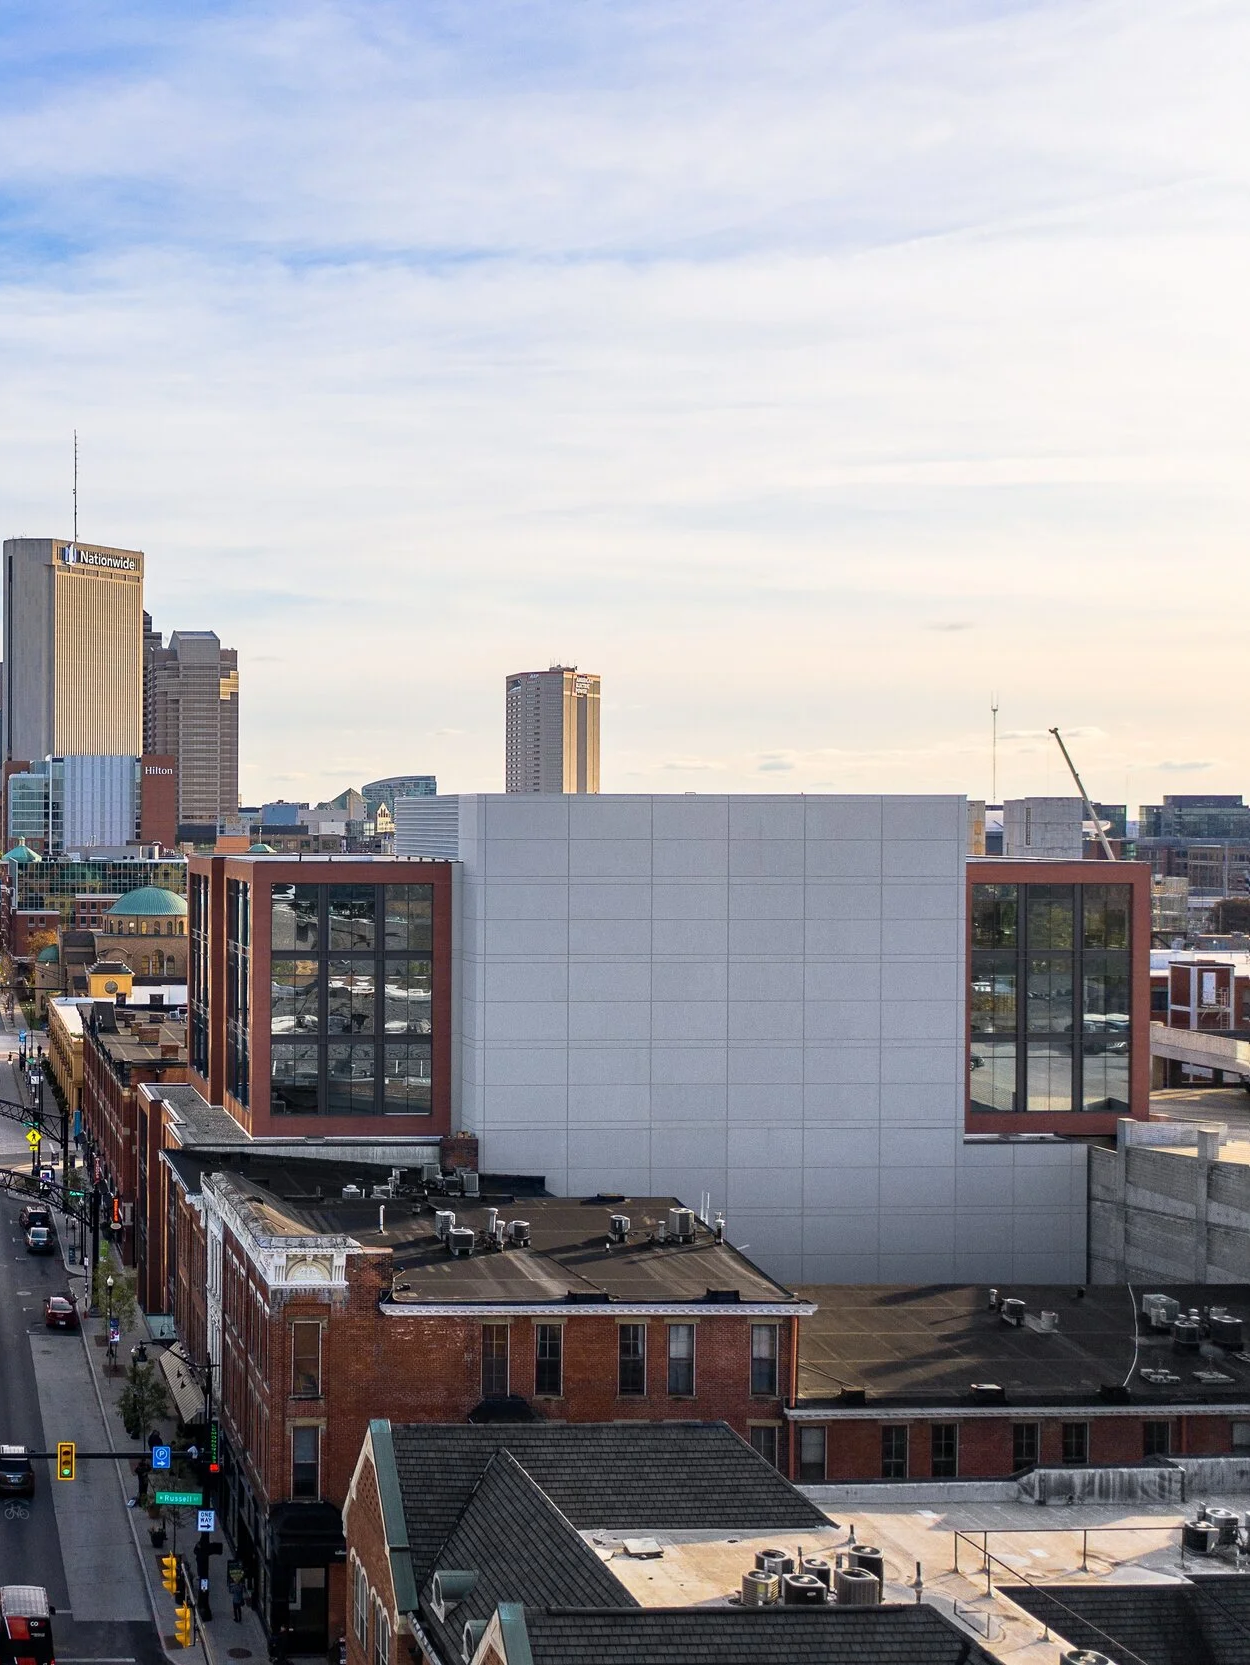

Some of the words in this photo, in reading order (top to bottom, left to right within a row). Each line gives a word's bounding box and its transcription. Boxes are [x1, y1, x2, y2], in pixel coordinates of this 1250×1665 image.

[80, 550, 135, 570] Nationwide
[145, 766, 173, 775] Hilton
[164, 1494, 192, 1503] Russell
